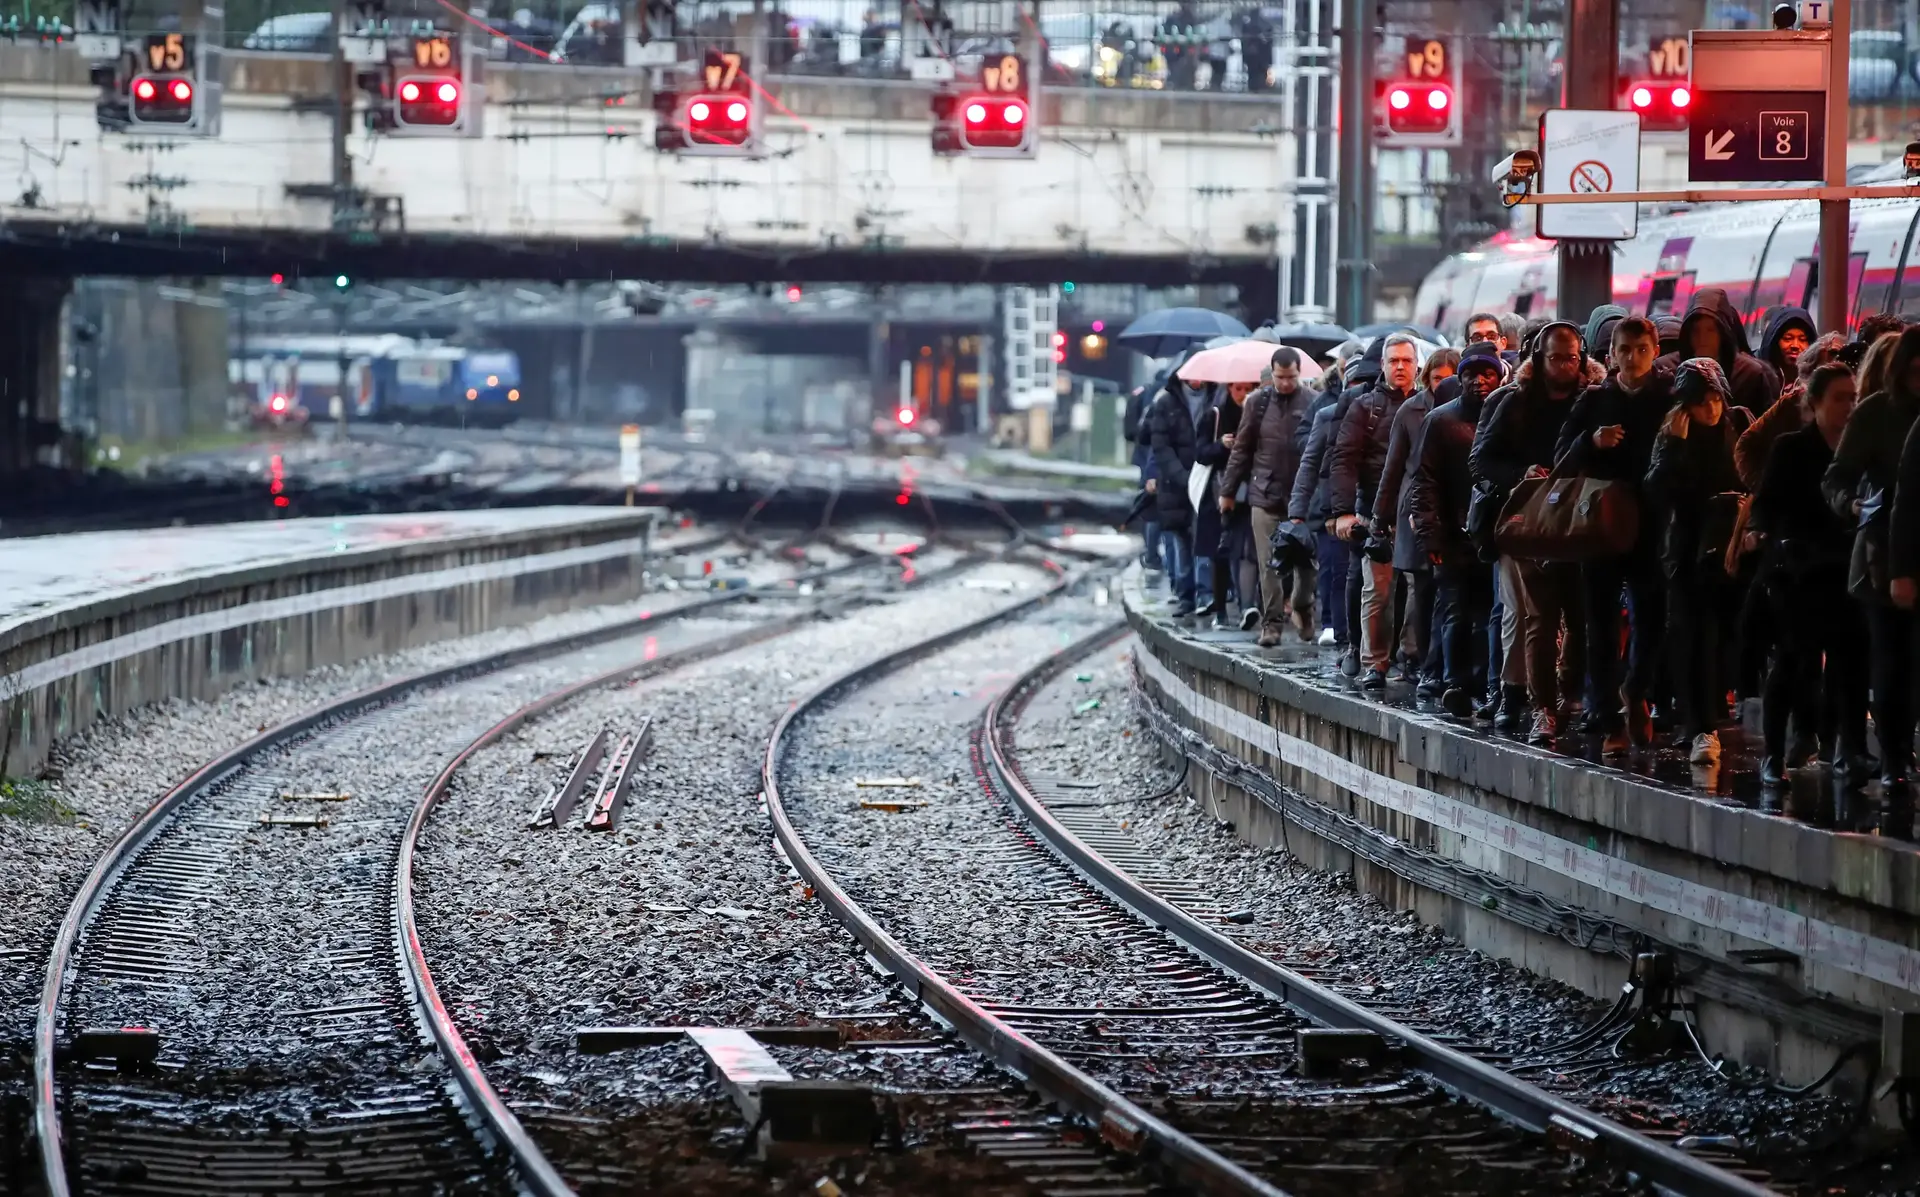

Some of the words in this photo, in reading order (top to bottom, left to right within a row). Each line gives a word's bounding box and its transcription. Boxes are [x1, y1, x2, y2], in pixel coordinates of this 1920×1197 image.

[1809, 3, 1822, 19] T
[150, 33, 184, 70] v5
[1408, 40, 1444, 77] v9
[1650, 38, 1689, 76] v10
[983, 55, 1019, 92] v8
[1773, 116, 1795, 126] Voie
[1776, 131, 1791, 154] 8
